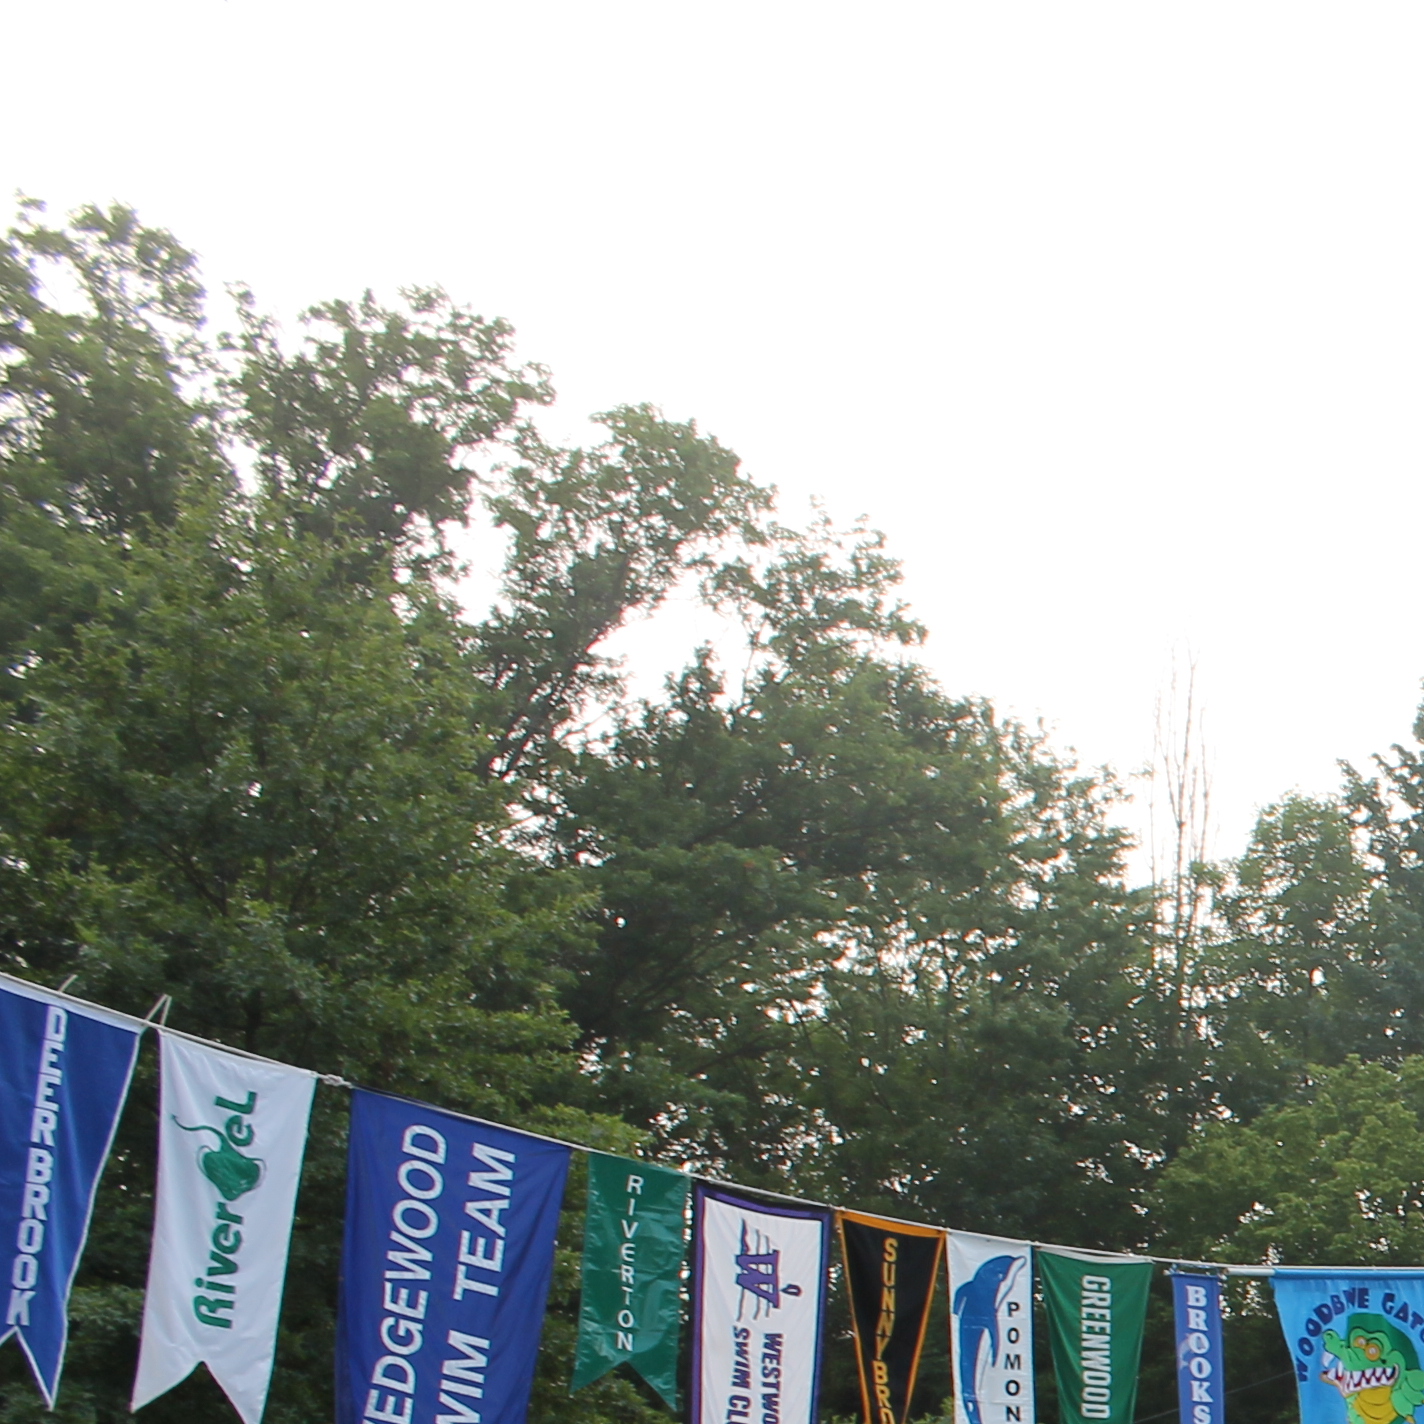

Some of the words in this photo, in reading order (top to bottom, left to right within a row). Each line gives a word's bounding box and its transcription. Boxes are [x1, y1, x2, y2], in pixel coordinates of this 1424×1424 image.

[8, 1006, 67, 1327] DEERBROOK
[454, 1142, 516, 1300] TEAM
[615, 1174, 644, 1352] RIVERTON
[731, 1327, 751, 1390] SWIM
[1080, 1275, 1111, 1419] GREENWOOD
